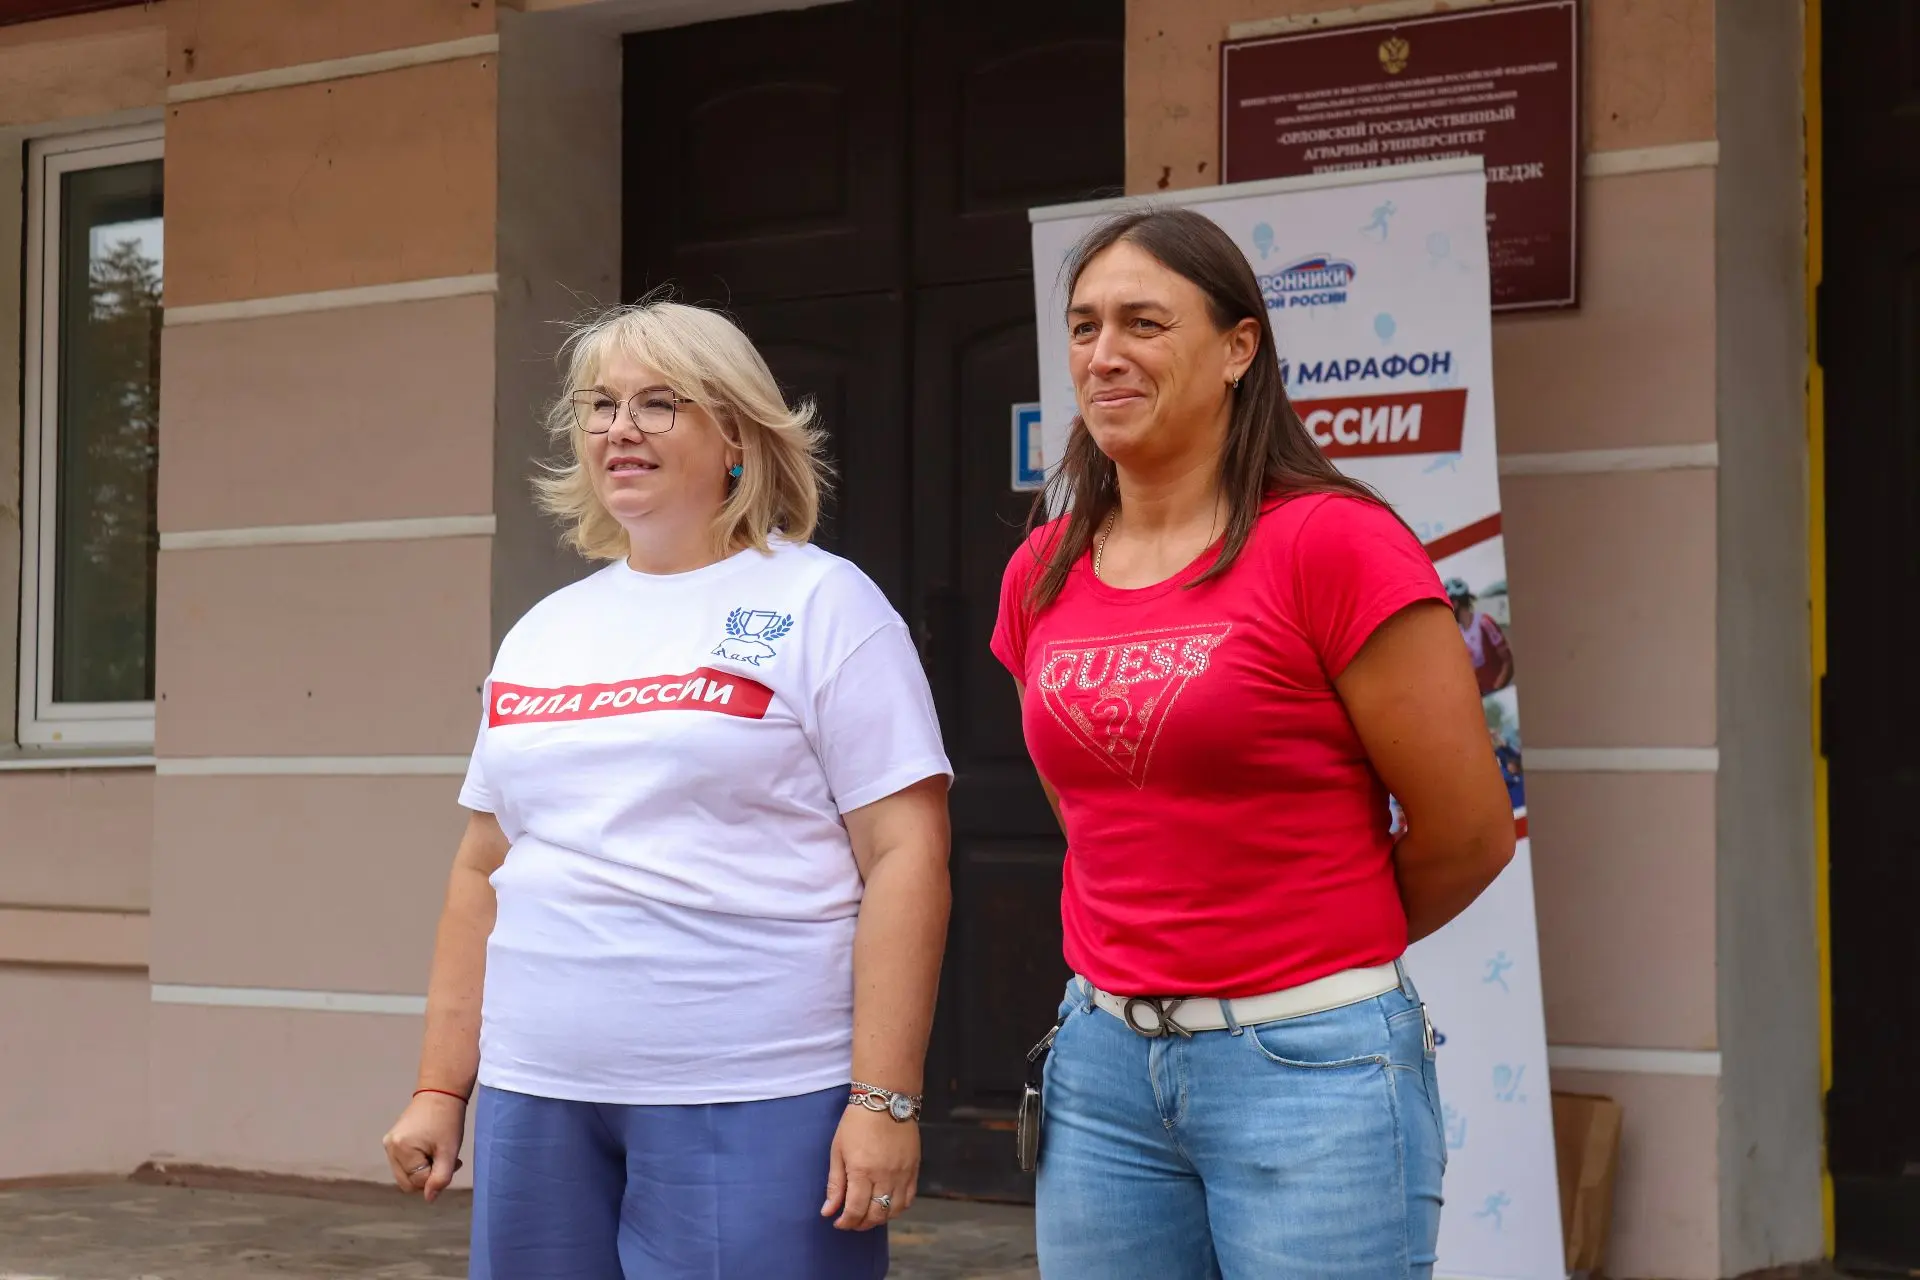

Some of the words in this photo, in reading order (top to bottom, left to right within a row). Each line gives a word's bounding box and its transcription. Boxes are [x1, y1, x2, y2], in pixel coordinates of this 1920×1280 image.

[1369, 105, 1516, 139] ГОСУДАРСТВЕННЫЙ
[1304, 138, 1379, 161] АГРАРНЫЙ
[1382, 129, 1487, 153] УНИВЕРСИТЕТ
[1486, 163, 1544, 183] ЛЕДЖ
[1258, 269, 1347, 293] РОННИКИ
[1290, 291, 1347, 308] РОССИИ
[1297, 352, 1452, 385] МАРАФОН
[1040, 638, 1208, 690] GUESS
[495, 692, 581, 716] СИЛА
[589, 676, 734, 711] РОССИИ
